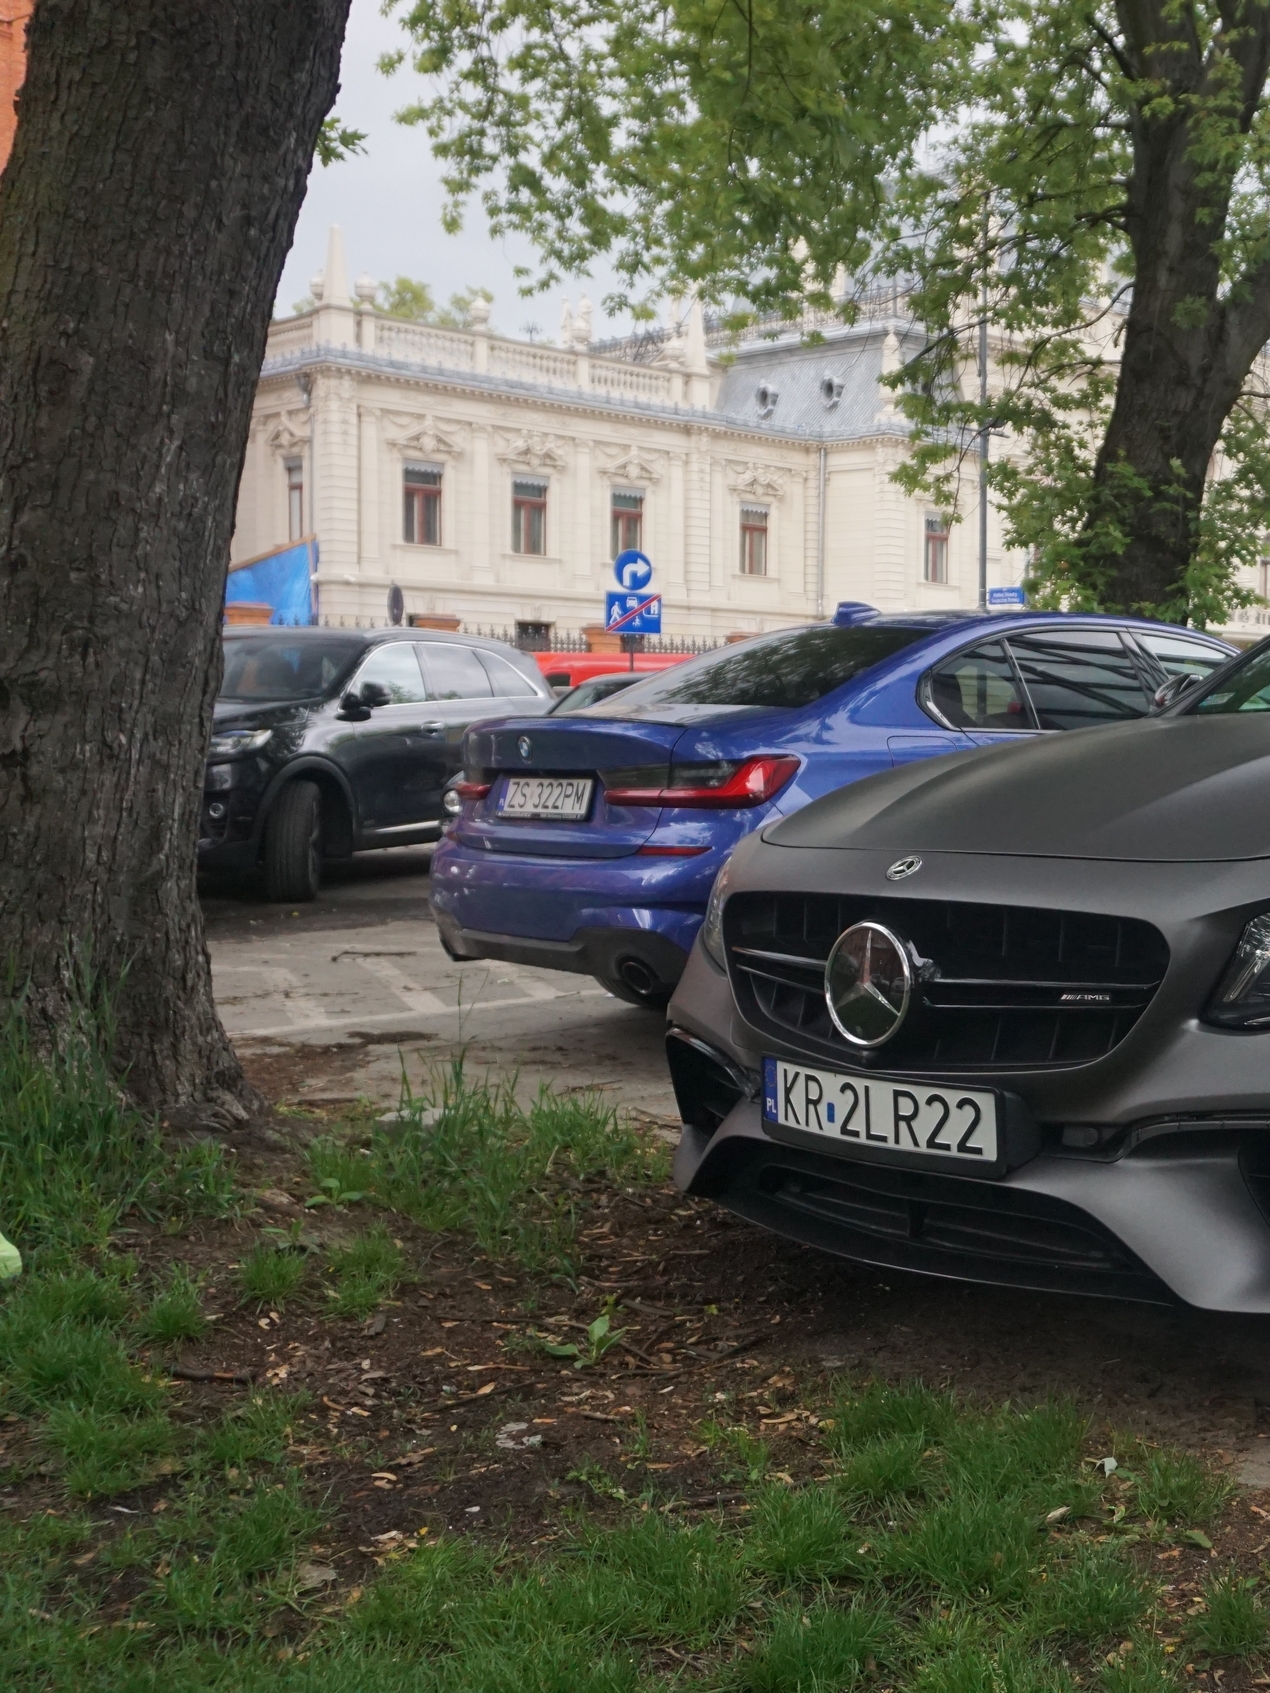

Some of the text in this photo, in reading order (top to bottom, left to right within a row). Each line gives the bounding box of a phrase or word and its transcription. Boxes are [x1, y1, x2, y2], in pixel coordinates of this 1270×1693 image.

[507, 781, 586, 810] ZS 322PM
[766, 1097, 777, 1114] PL
[783, 1067, 984, 1156] KR 2LR22
